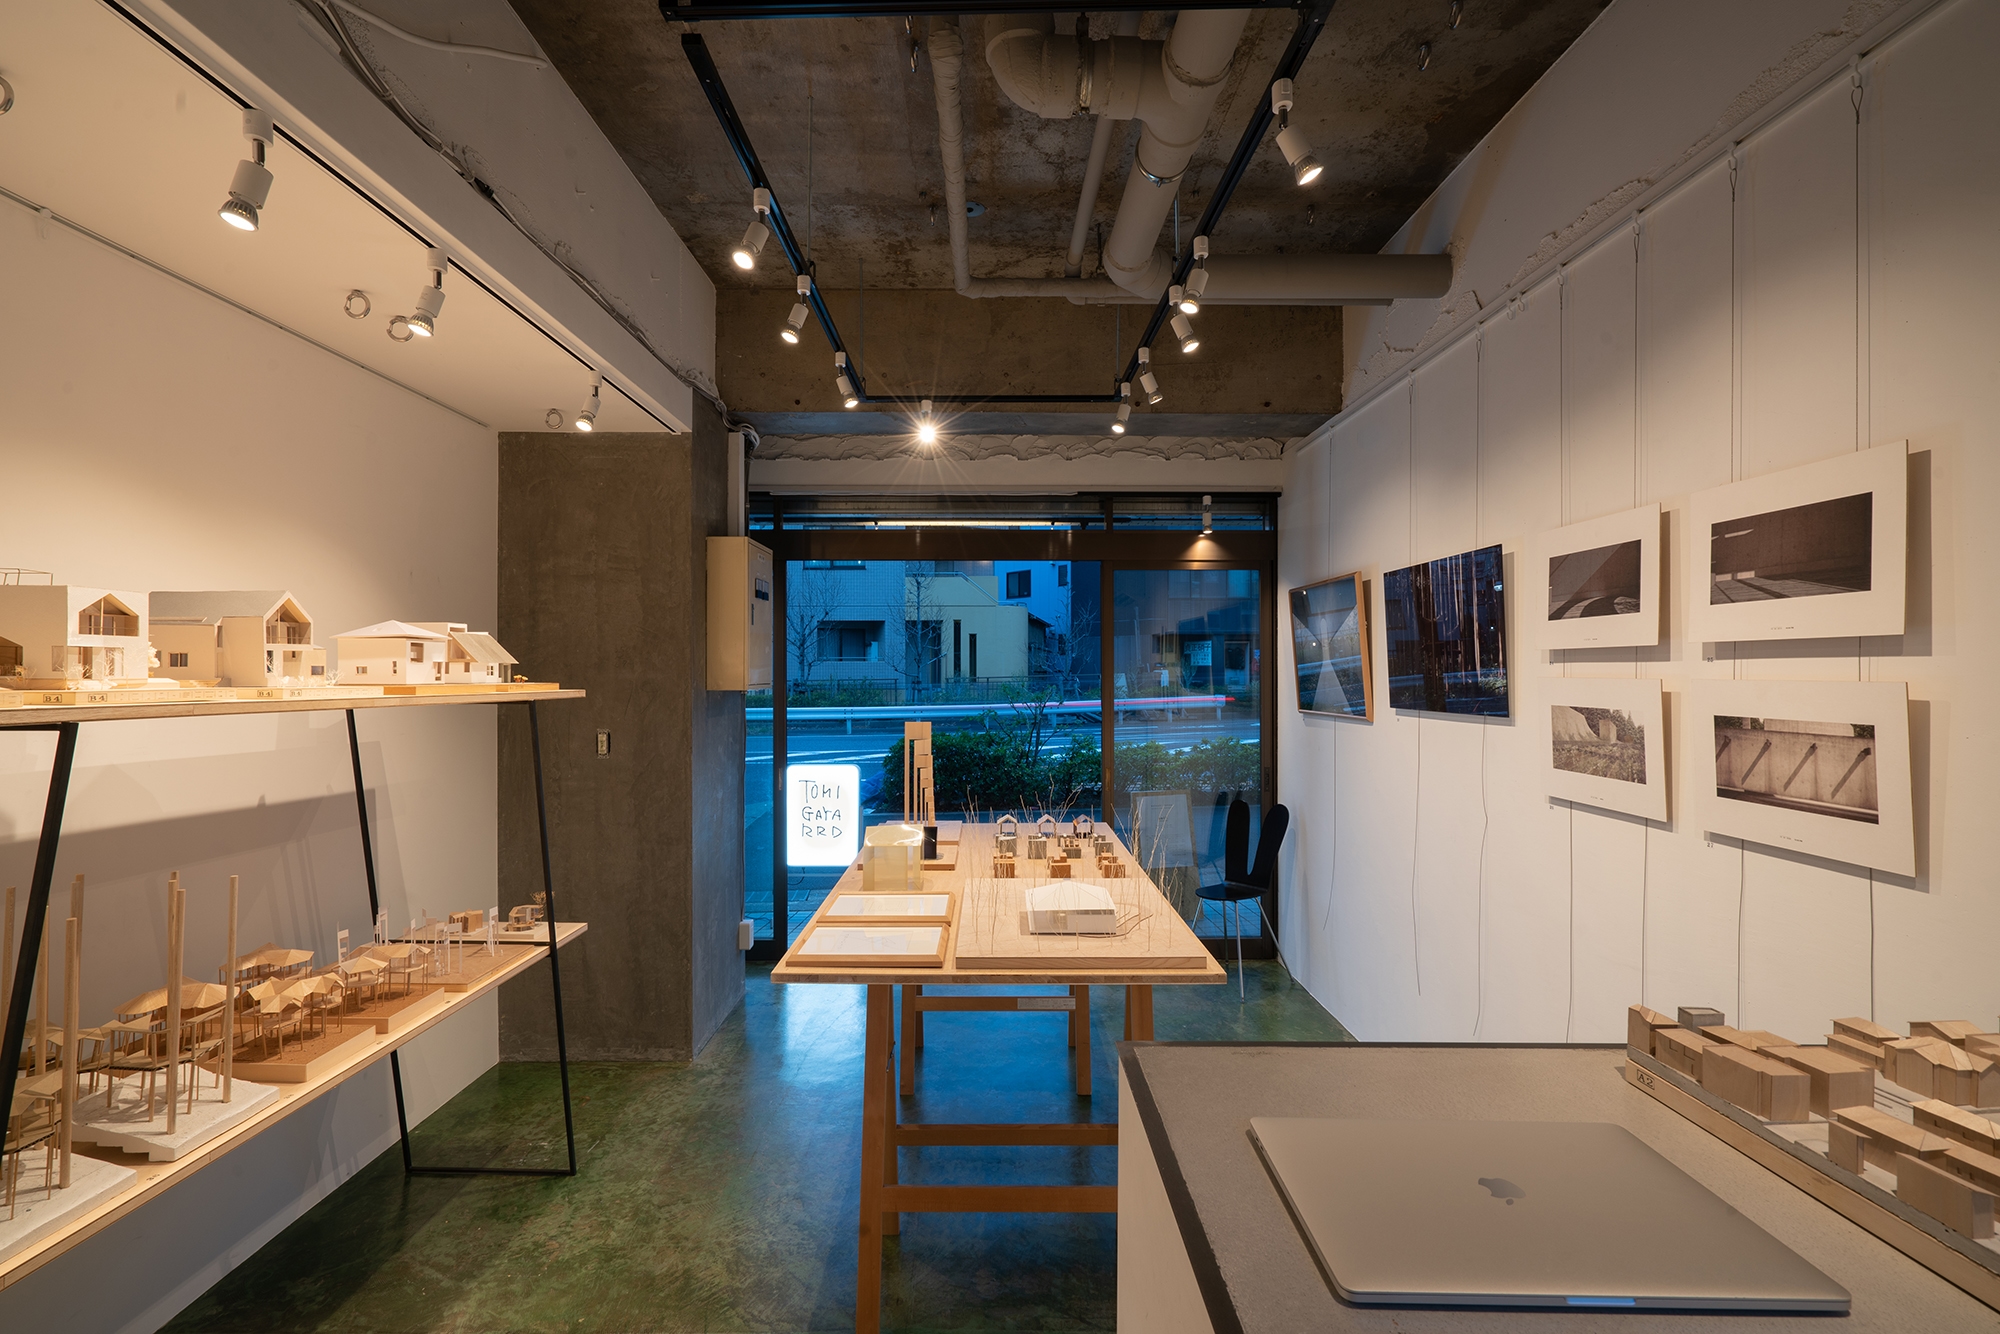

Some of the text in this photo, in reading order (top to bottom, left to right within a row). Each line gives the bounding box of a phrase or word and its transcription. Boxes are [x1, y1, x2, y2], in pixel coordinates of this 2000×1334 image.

[799, 780, 840, 803] TOMI
[802, 806, 841, 821] GAYA
[802, 823, 842, 838] RRD
[1638, 1074, 1654, 1089] A2
